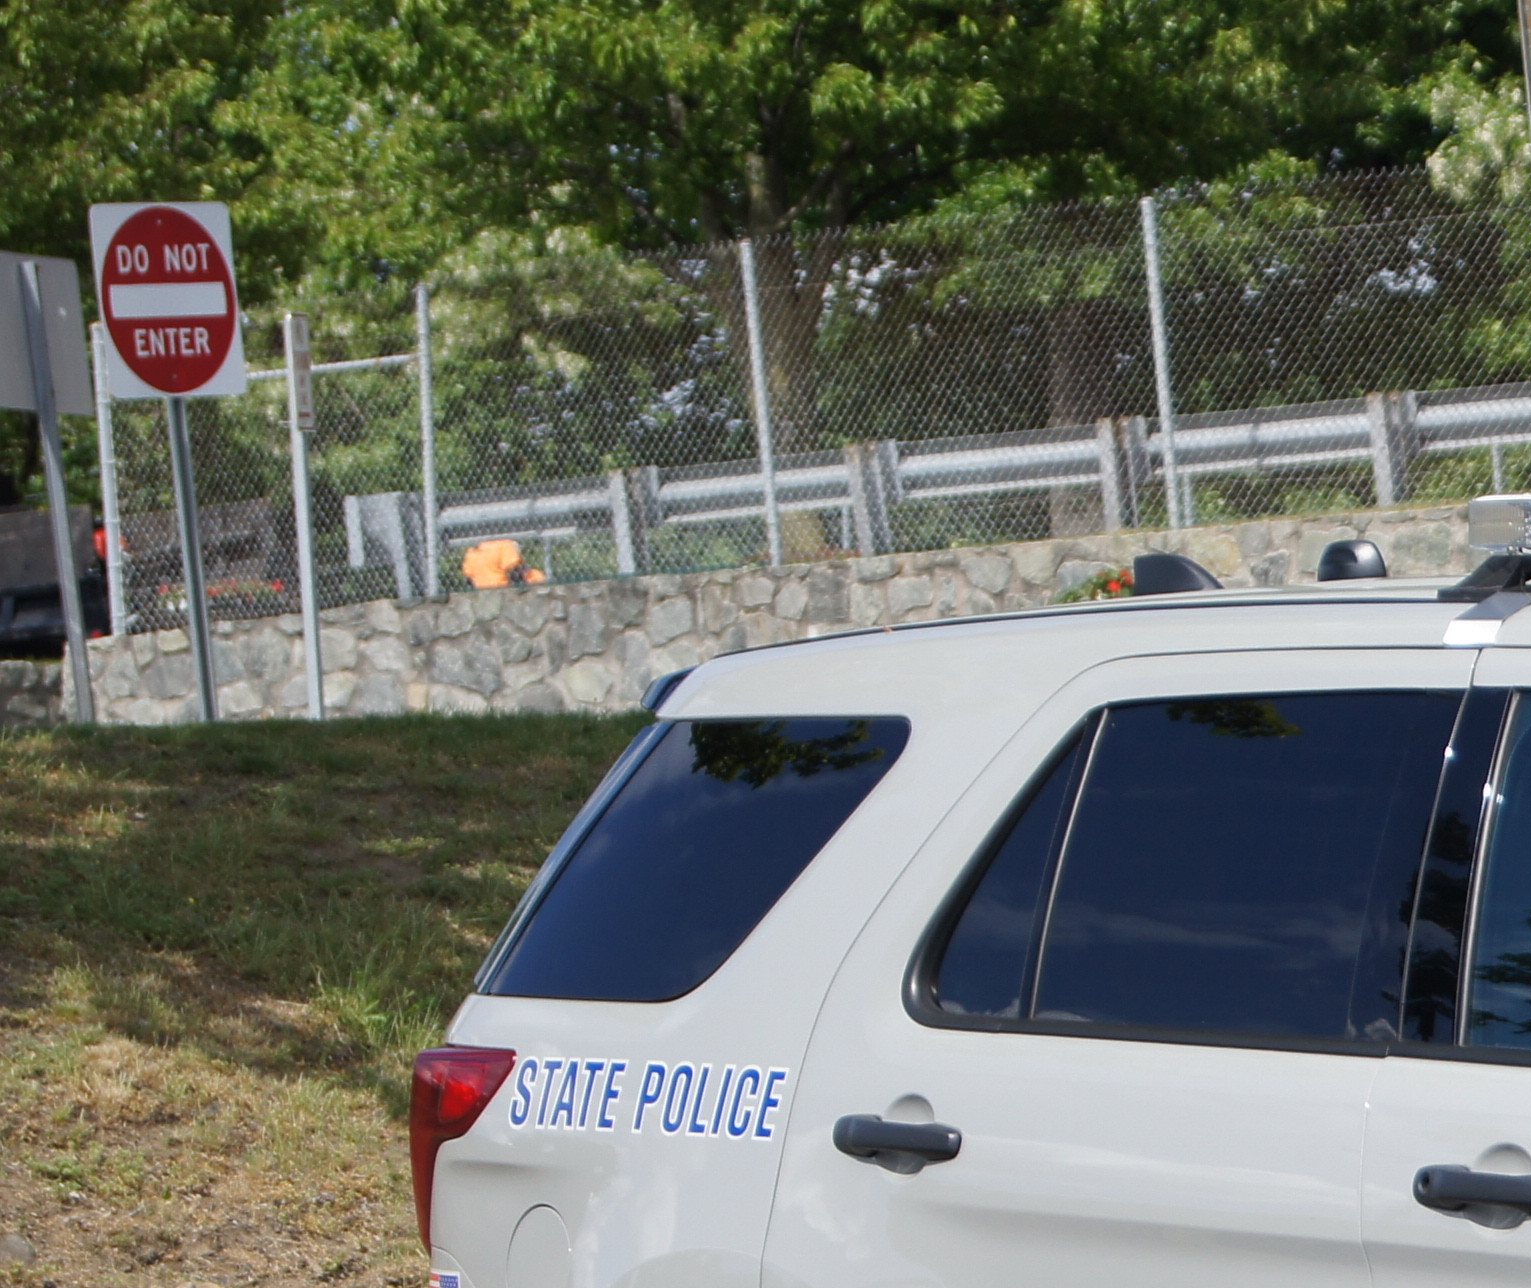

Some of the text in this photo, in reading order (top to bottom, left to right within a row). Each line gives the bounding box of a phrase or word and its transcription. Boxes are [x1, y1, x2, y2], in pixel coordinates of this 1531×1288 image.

[115, 243, 210, 274] DO NOT
[134, 326, 211, 357] ENTER
[509, 1056, 790, 1141] STATE POLICE
